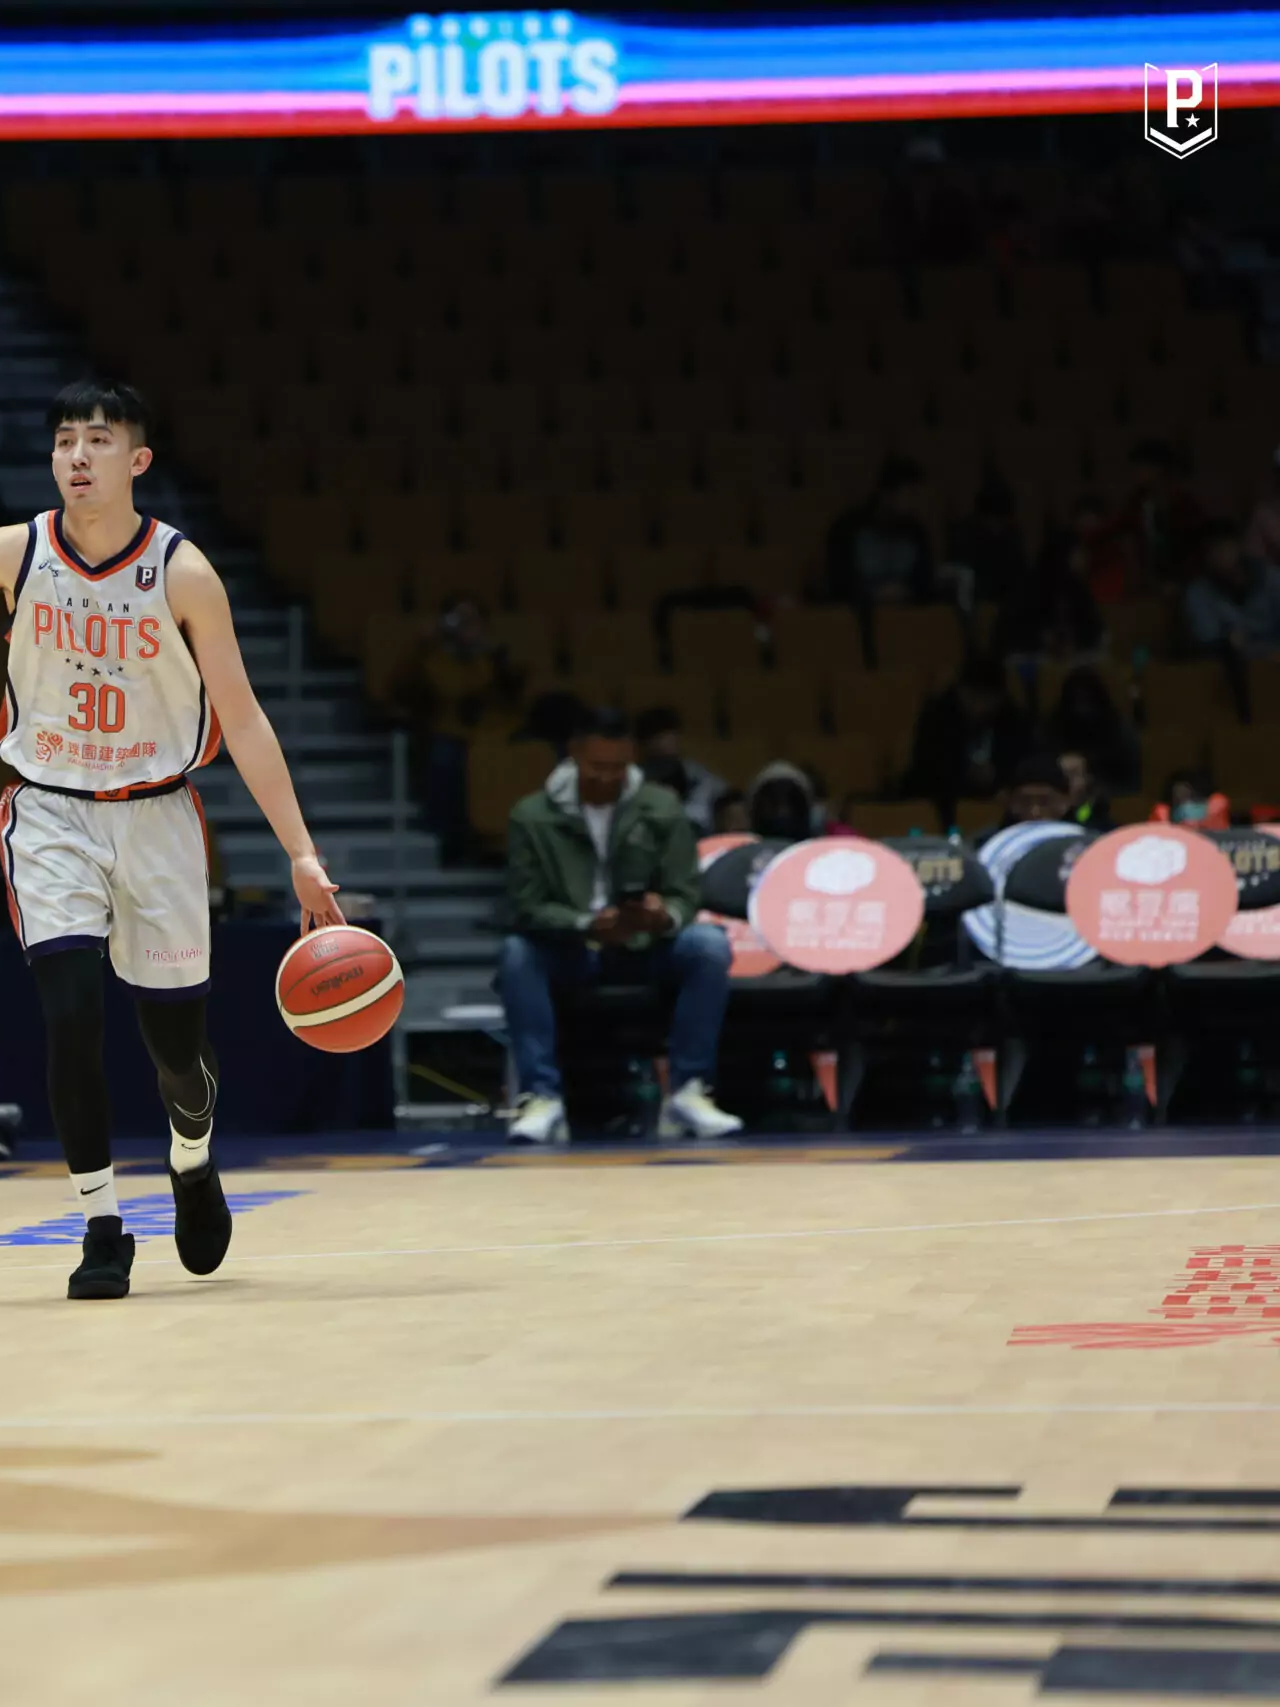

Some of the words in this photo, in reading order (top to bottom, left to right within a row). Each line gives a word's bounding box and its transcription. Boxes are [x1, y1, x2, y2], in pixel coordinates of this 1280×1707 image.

[367, 39, 618, 121] PILOTS
[32, 602, 161, 661] PILOTS
[68, 682, 126, 733] 30
